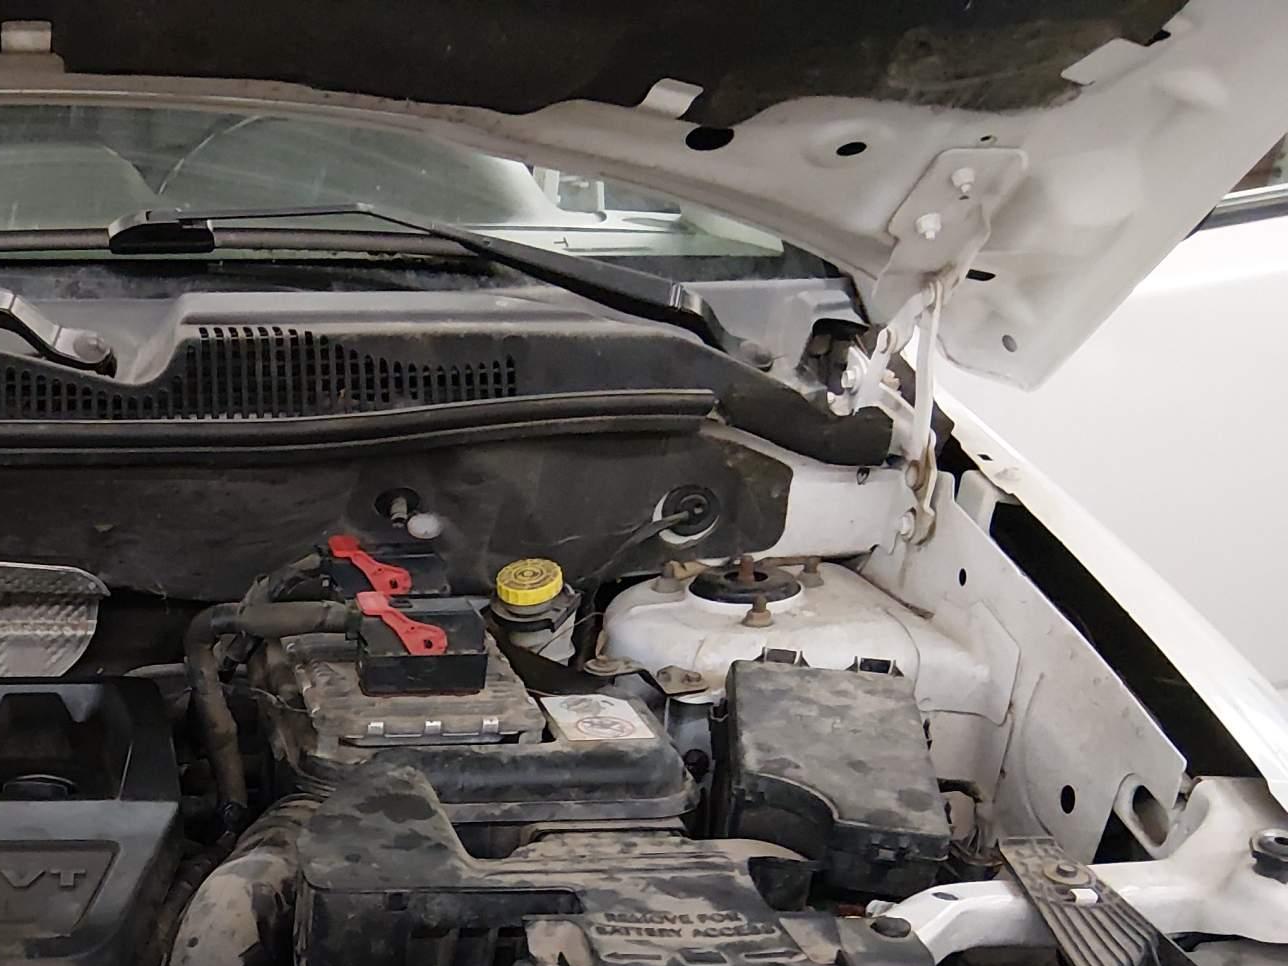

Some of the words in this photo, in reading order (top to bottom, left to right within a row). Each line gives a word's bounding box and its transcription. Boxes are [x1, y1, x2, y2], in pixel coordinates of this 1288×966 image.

[603, 911, 694, 925] REMOVE
[696, 911, 743, 924] FOR
[594, 925, 682, 938] BATTERY
[692, 924, 777, 938] ACCESS
